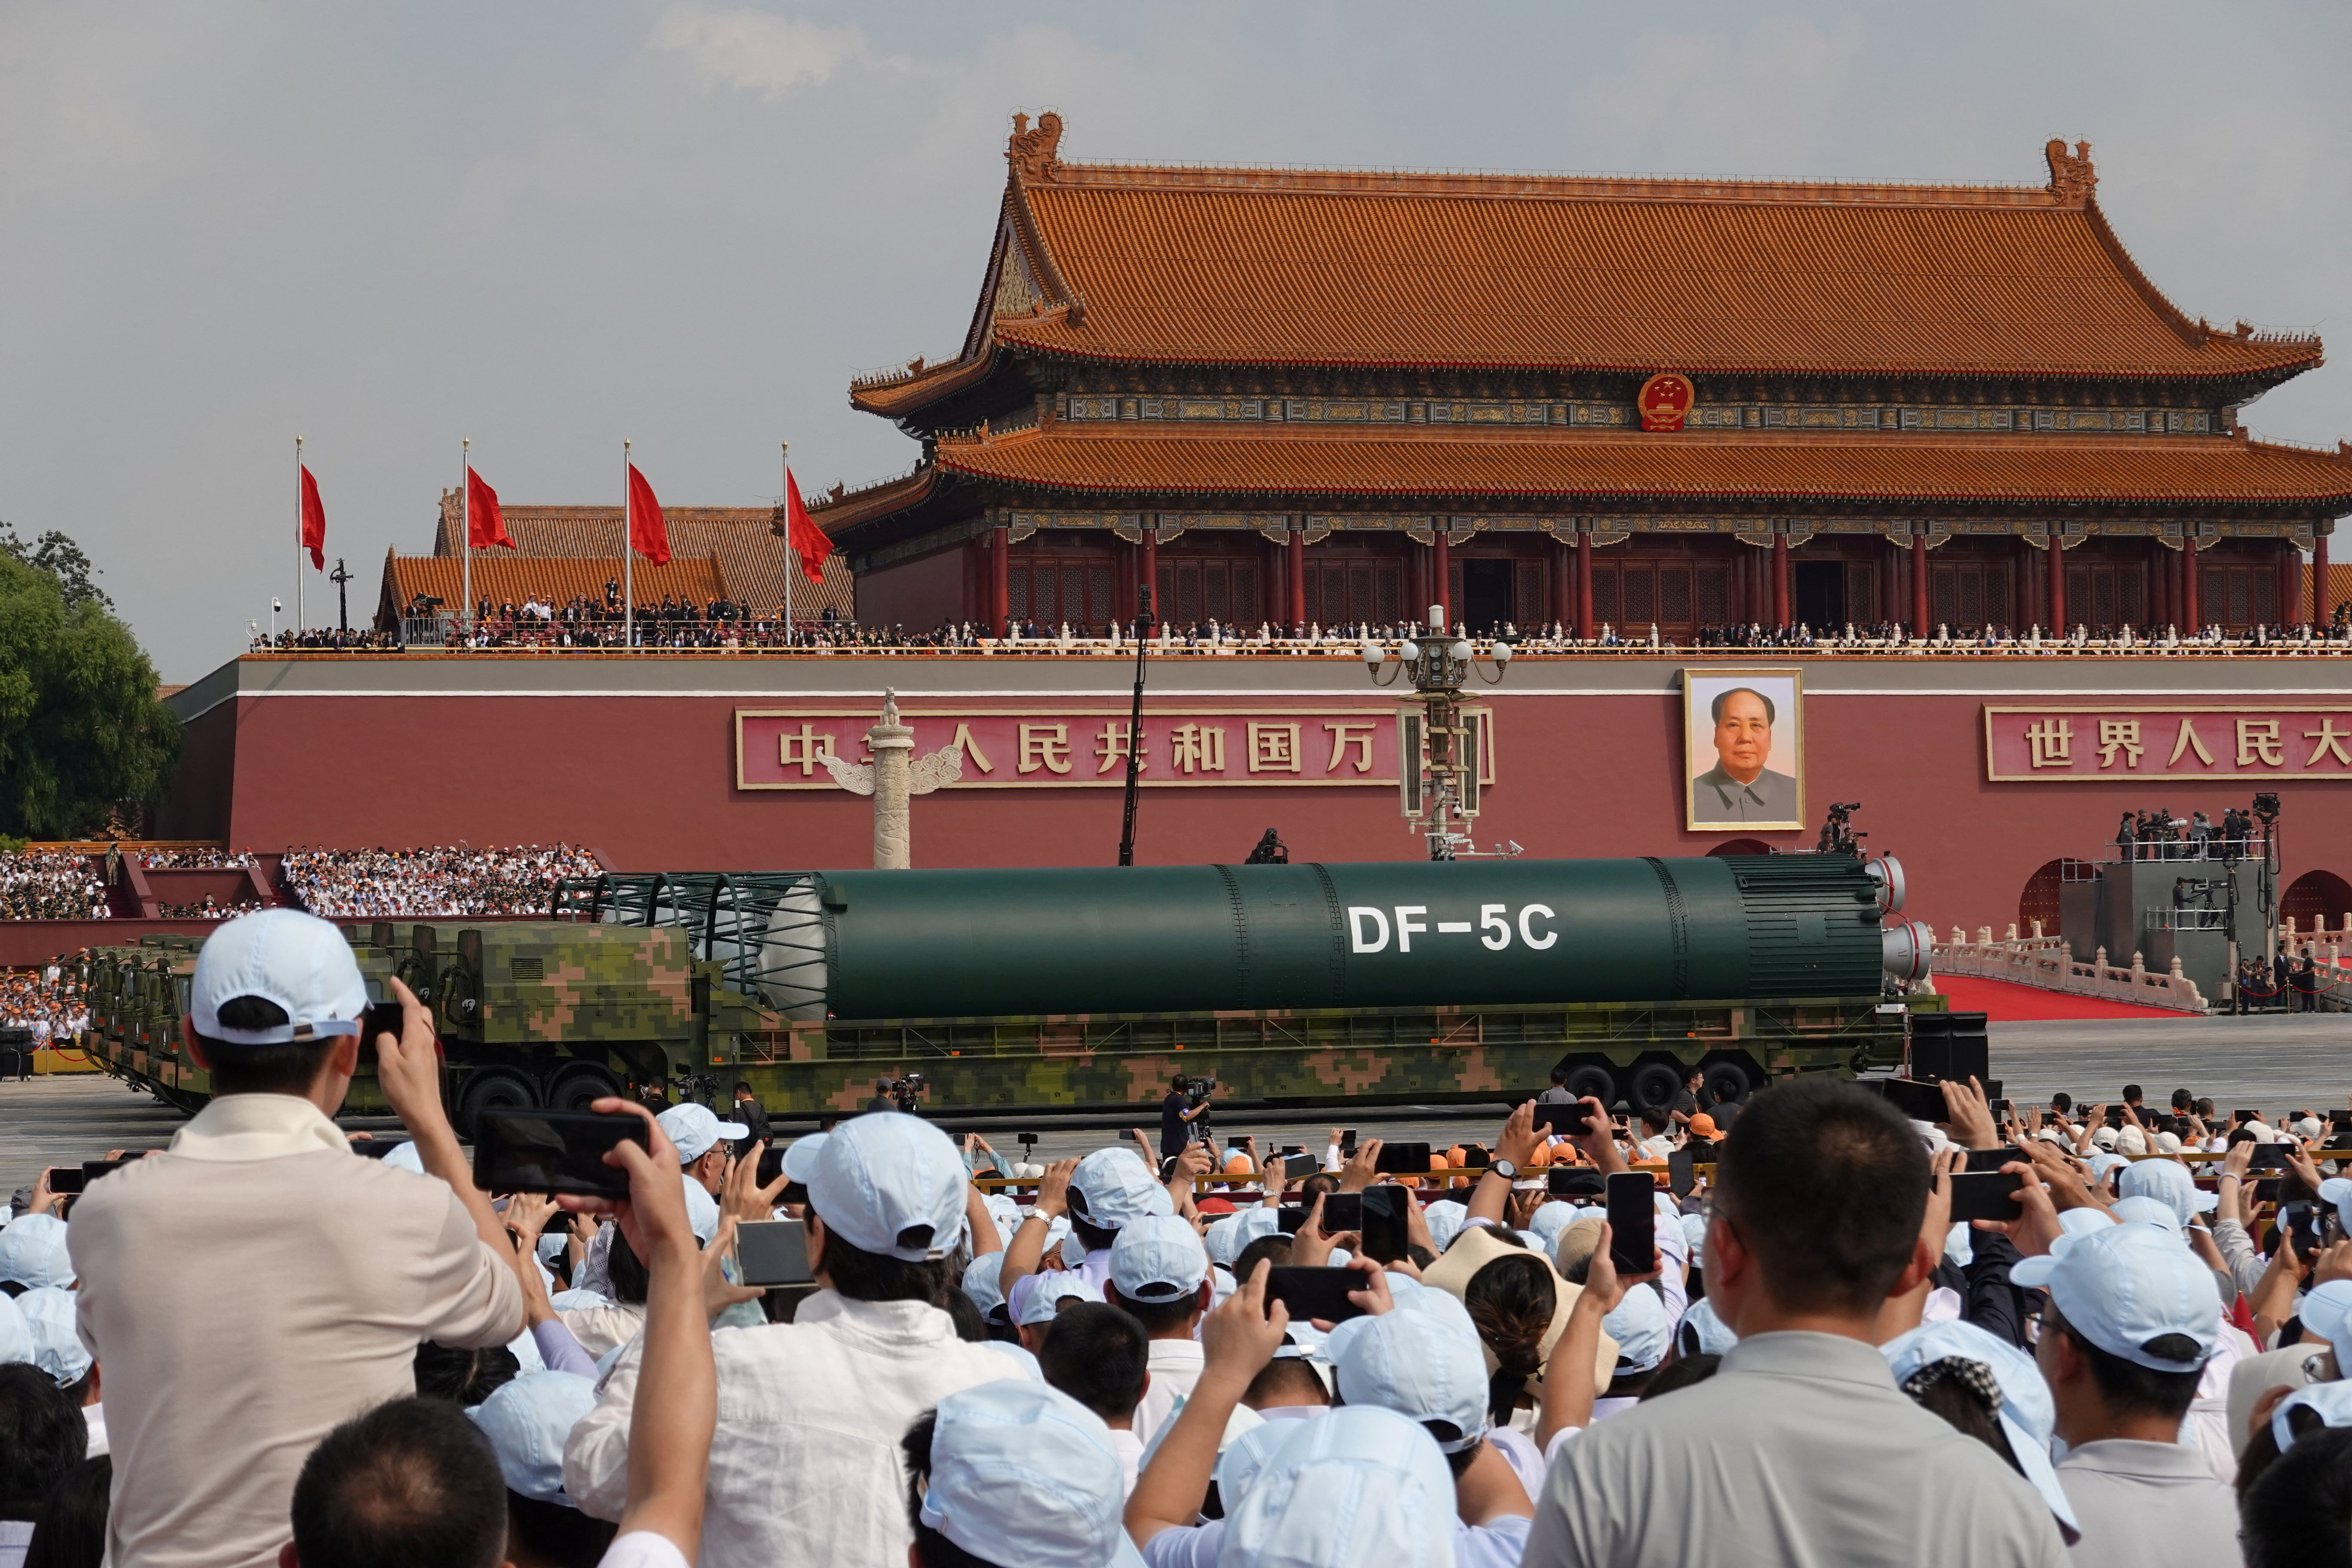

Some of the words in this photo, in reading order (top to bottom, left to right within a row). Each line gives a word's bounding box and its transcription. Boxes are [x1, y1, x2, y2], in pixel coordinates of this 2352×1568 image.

[780, 723, 1453, 775] 中人民共和国万
[2025, 719, 2352, 768] 世界人民大
[1348, 903, 1558, 953] DF-5C
